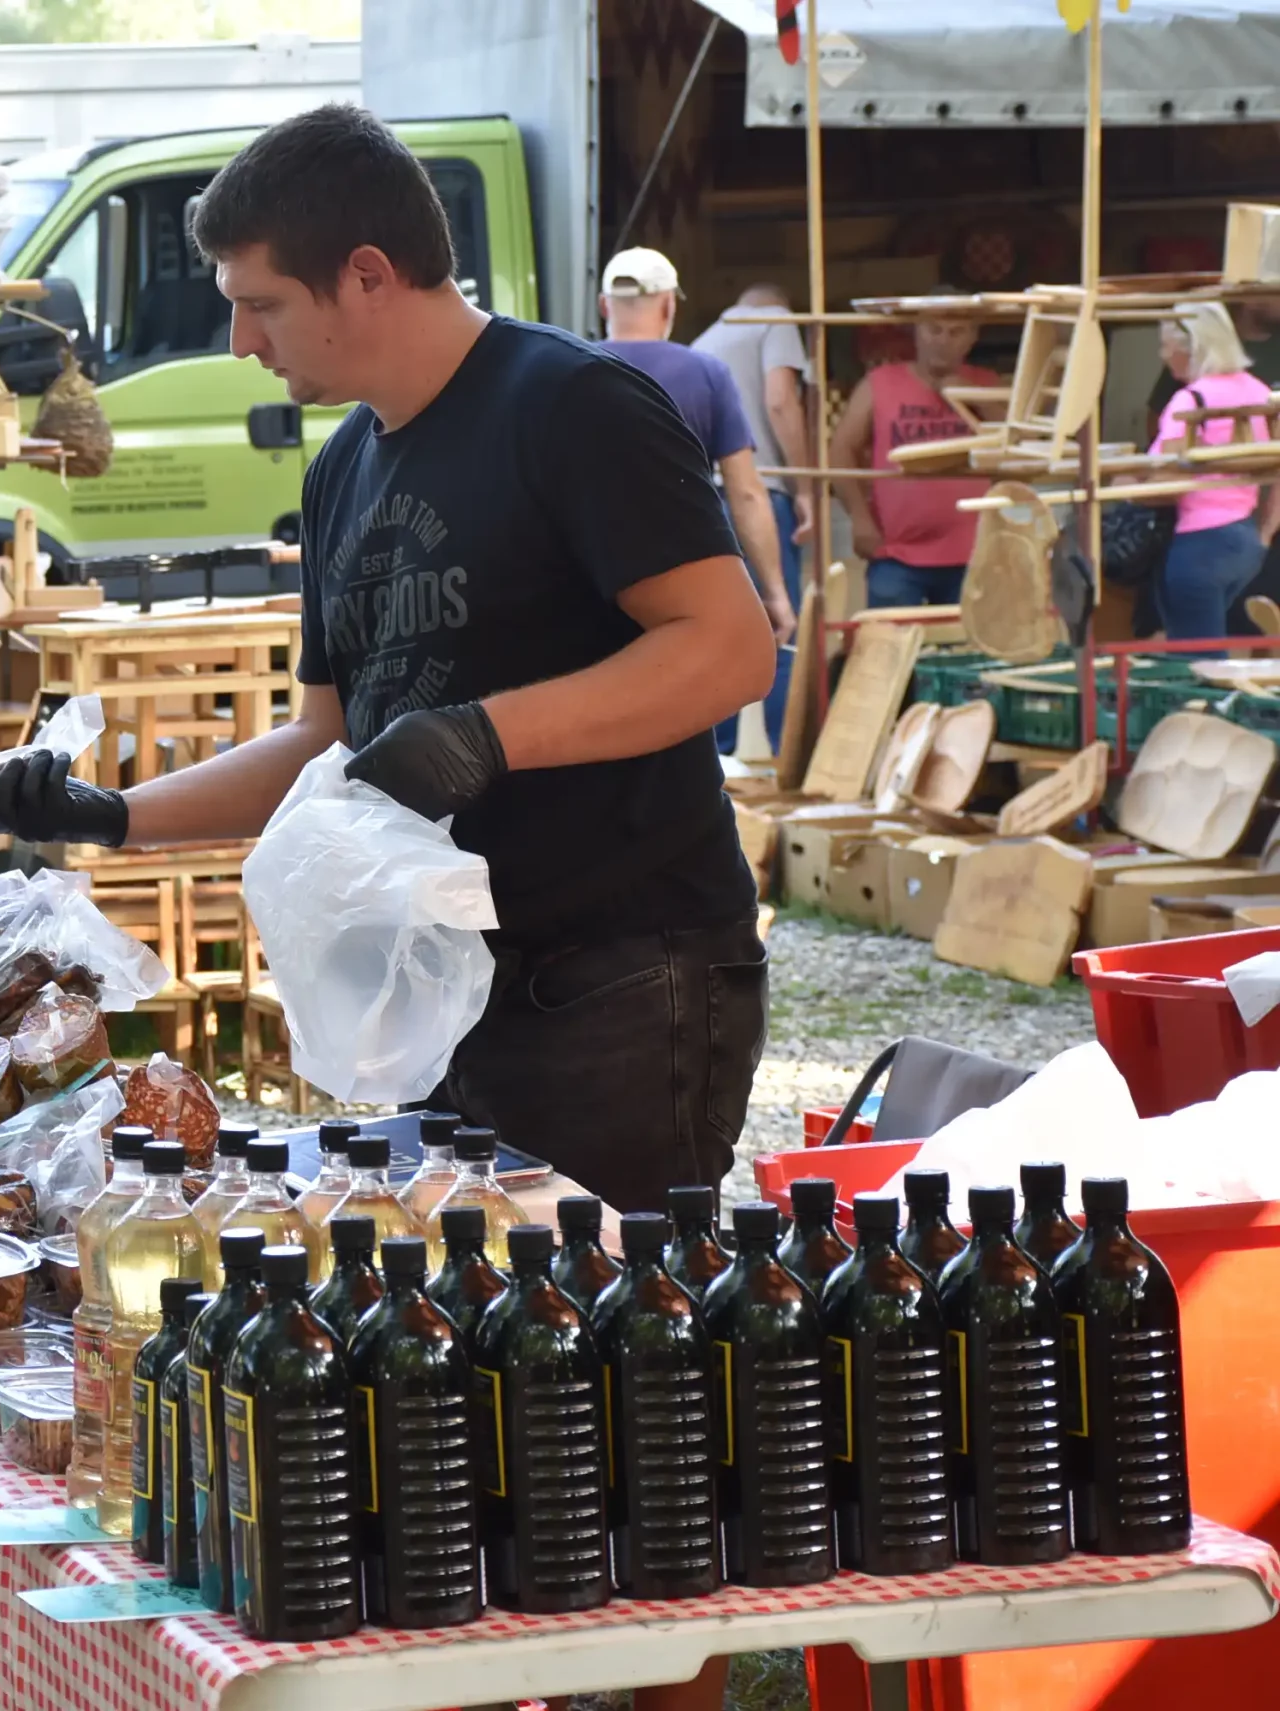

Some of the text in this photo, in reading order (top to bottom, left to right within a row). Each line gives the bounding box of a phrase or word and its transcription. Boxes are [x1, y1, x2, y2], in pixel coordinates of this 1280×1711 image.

[326, 525, 357, 580] TOM
[359, 493, 414, 538] TAYLOR
[325, 590, 370, 655] RY
